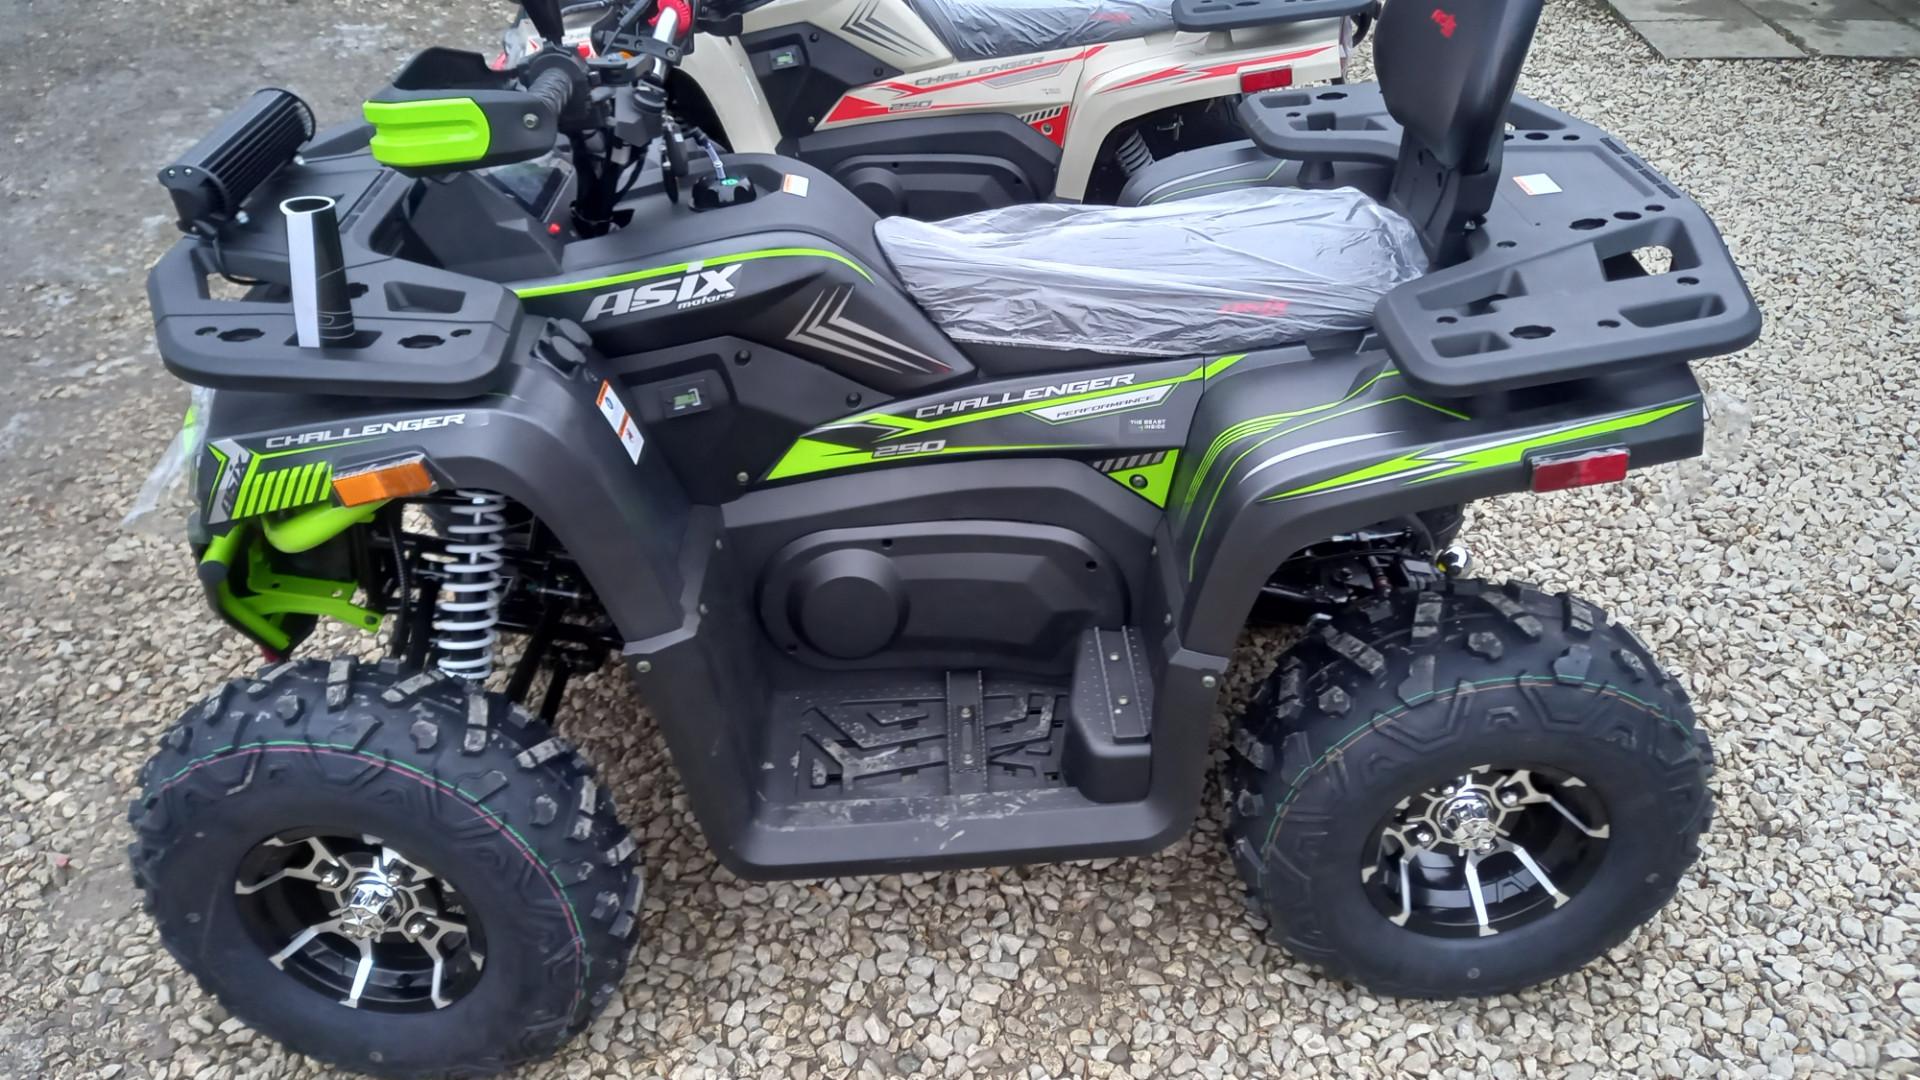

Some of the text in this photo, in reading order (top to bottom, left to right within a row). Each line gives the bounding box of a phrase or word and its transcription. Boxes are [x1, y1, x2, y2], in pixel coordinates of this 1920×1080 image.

[916, 56, 1044, 86] CHALLENGER
[890, 101, 932, 111] 250
[677, 290, 735, 310] motors
[915, 372, 1136, 418] CHALLENGER
[1056, 395, 1155, 418] PERFORMANCE
[266, 413, 465, 449] CHALLENGER
[873, 440, 947, 458] 250
